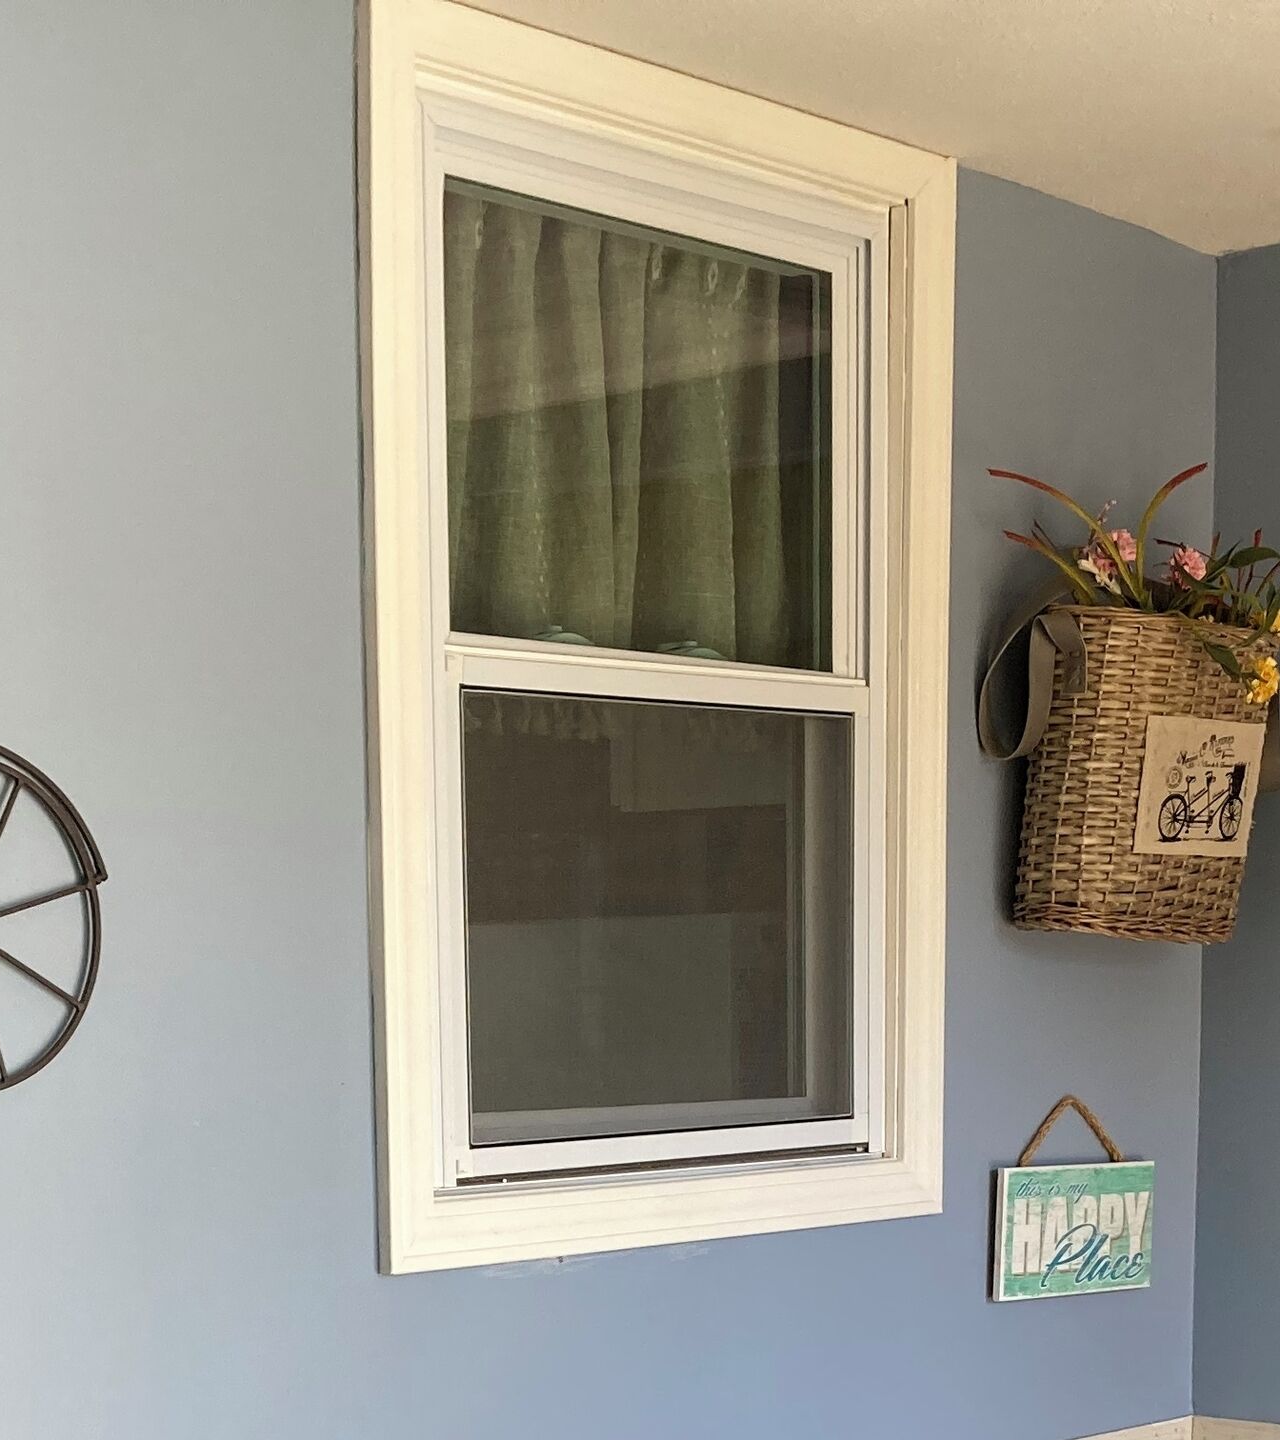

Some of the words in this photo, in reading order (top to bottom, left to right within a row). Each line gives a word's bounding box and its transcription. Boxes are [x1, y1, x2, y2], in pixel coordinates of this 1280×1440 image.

[1017, 1178, 1041, 1197] this
[1048, 1184, 1061, 1196] is
[1067, 1183, 1089, 1204] my
[1011, 1192, 1150, 1274] HAPPY
[1040, 1223, 1144, 1288] Place
